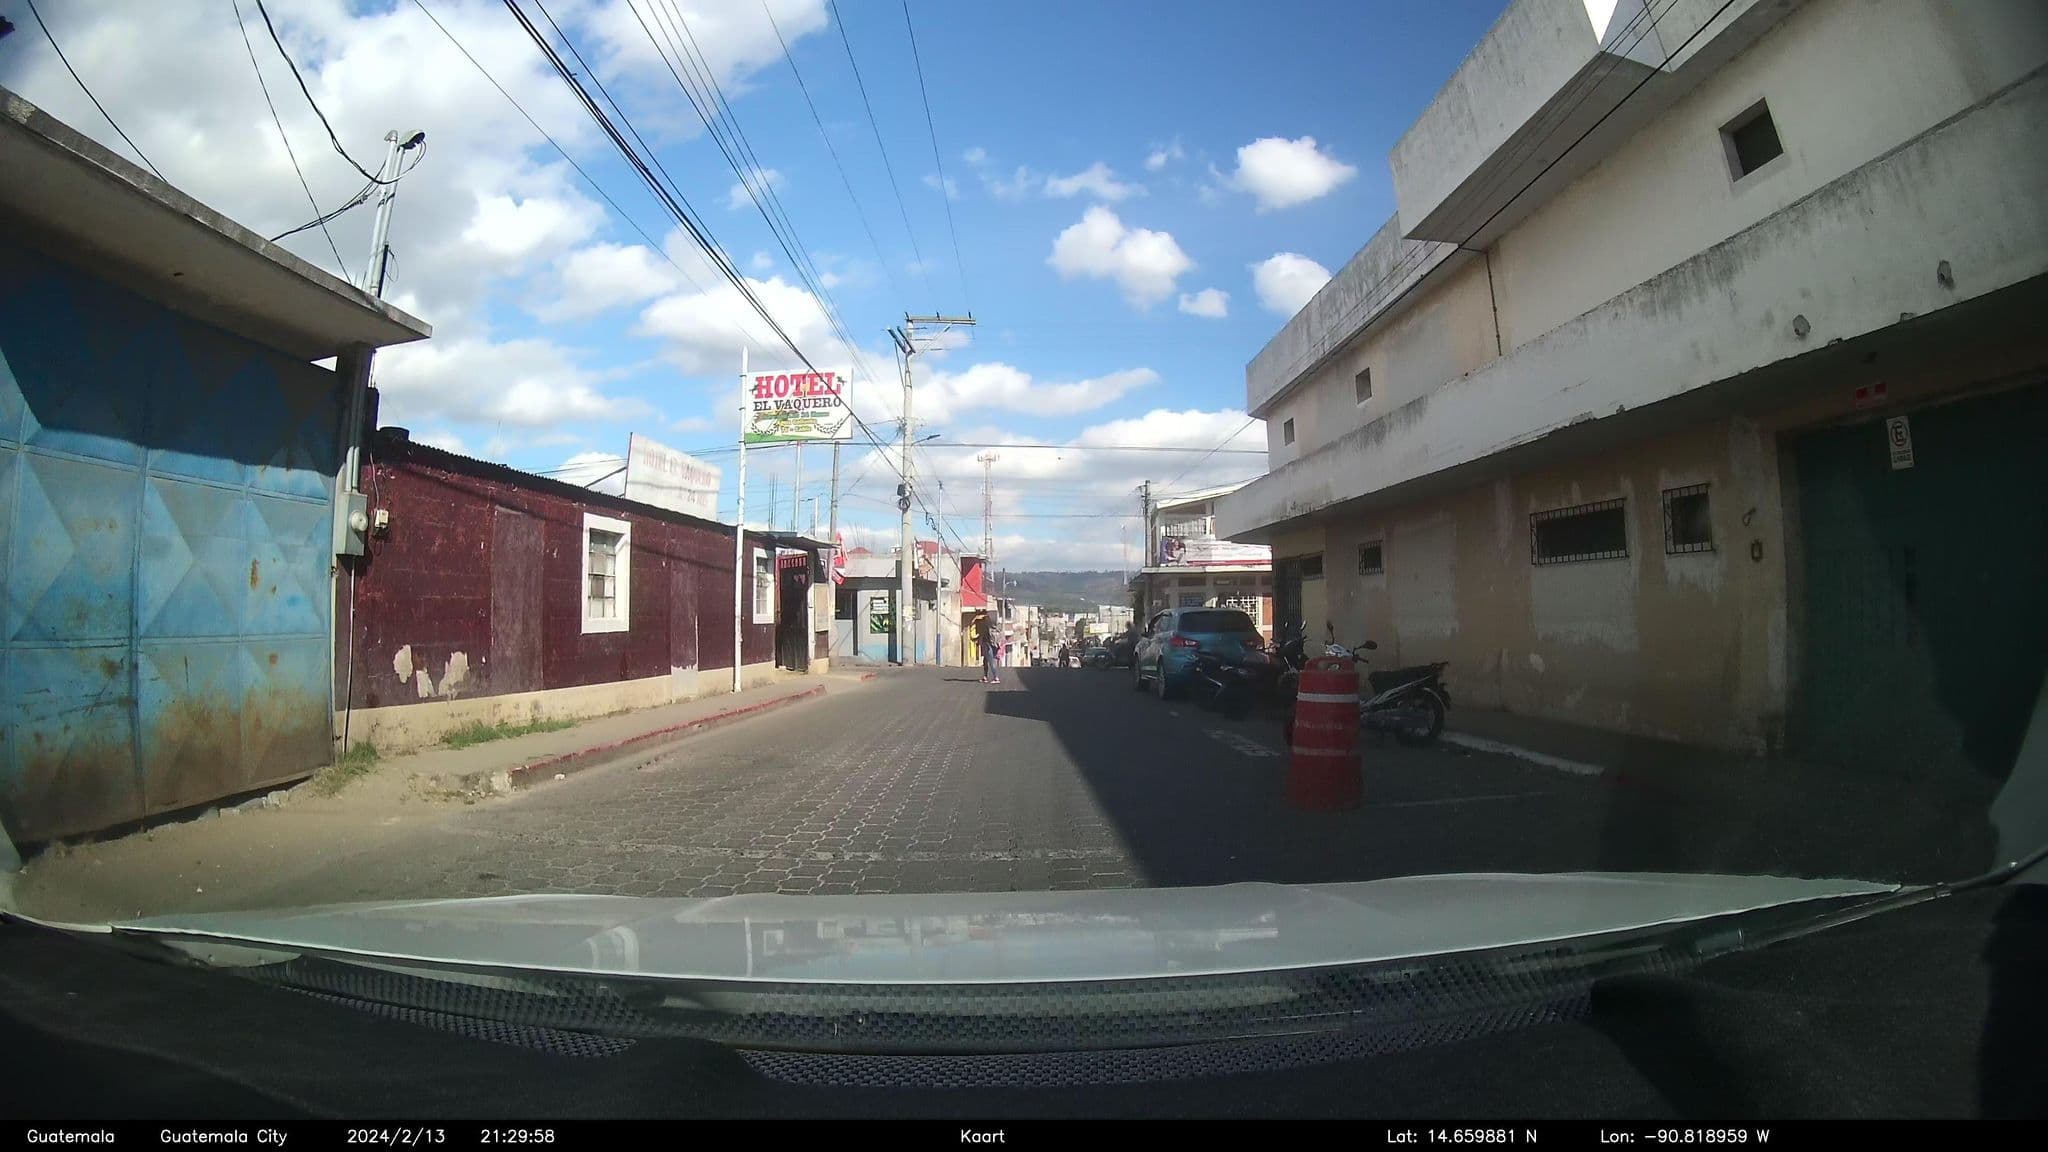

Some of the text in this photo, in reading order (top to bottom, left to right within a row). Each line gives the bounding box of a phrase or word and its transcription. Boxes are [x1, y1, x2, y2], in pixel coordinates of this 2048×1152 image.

[755, 372, 841, 399] HOTEL
[753, 397, 842, 412] EL VAQUERO
